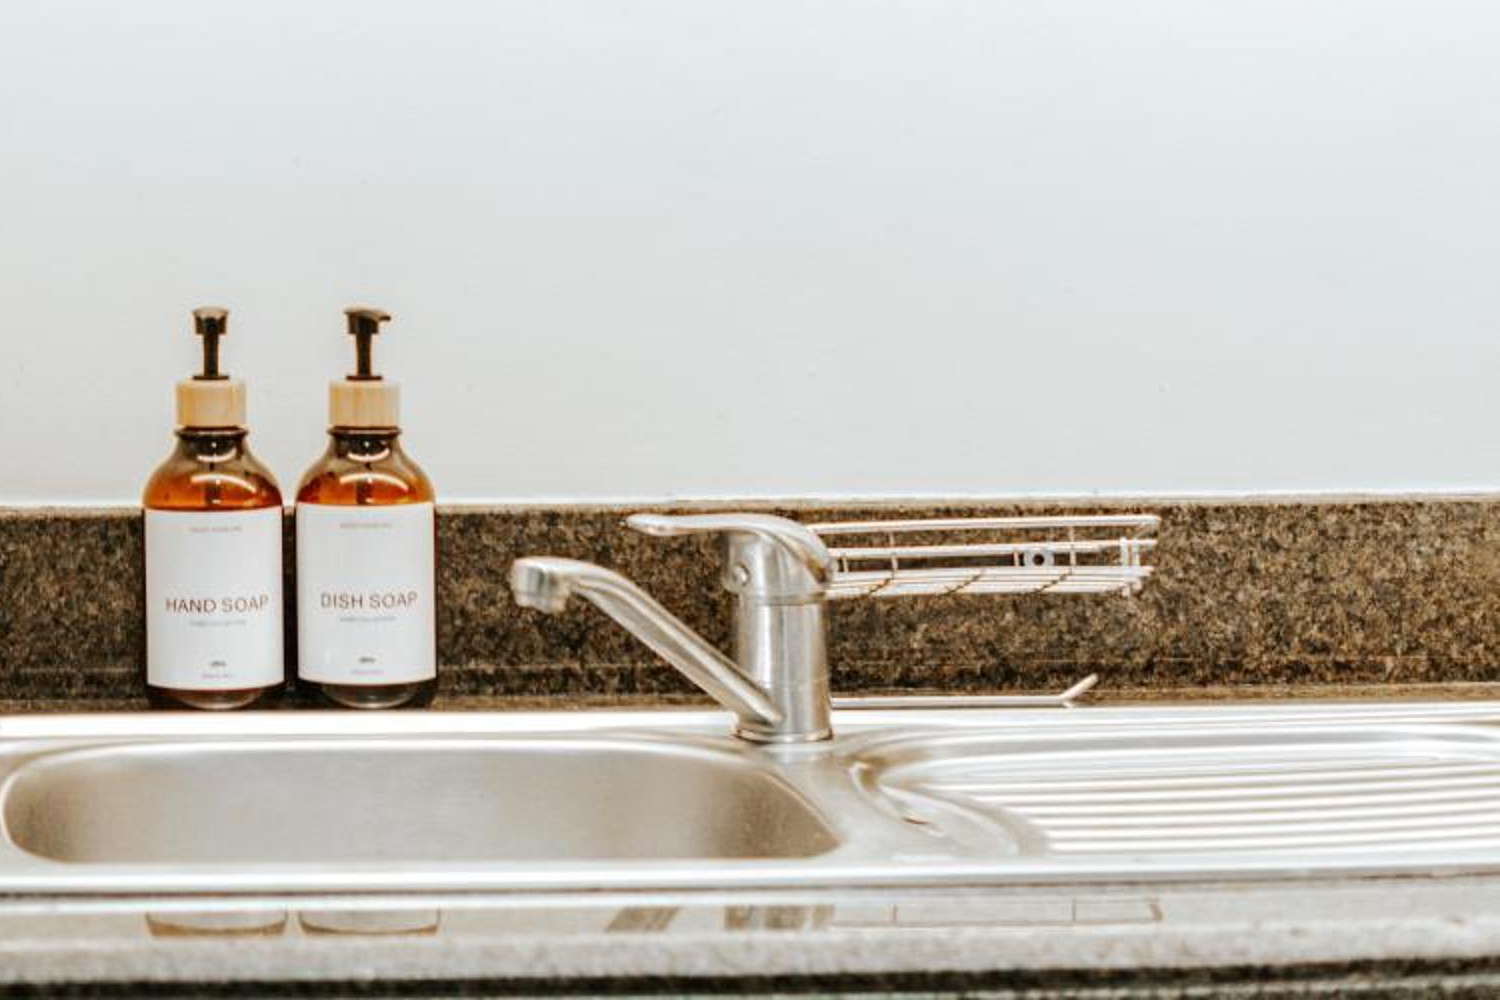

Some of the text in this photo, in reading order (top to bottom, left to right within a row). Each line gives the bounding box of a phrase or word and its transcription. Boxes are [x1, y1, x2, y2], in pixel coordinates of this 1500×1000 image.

[165, 594, 269, 613] HAND SOAP
[320, 591, 418, 608] DISH SOAP
